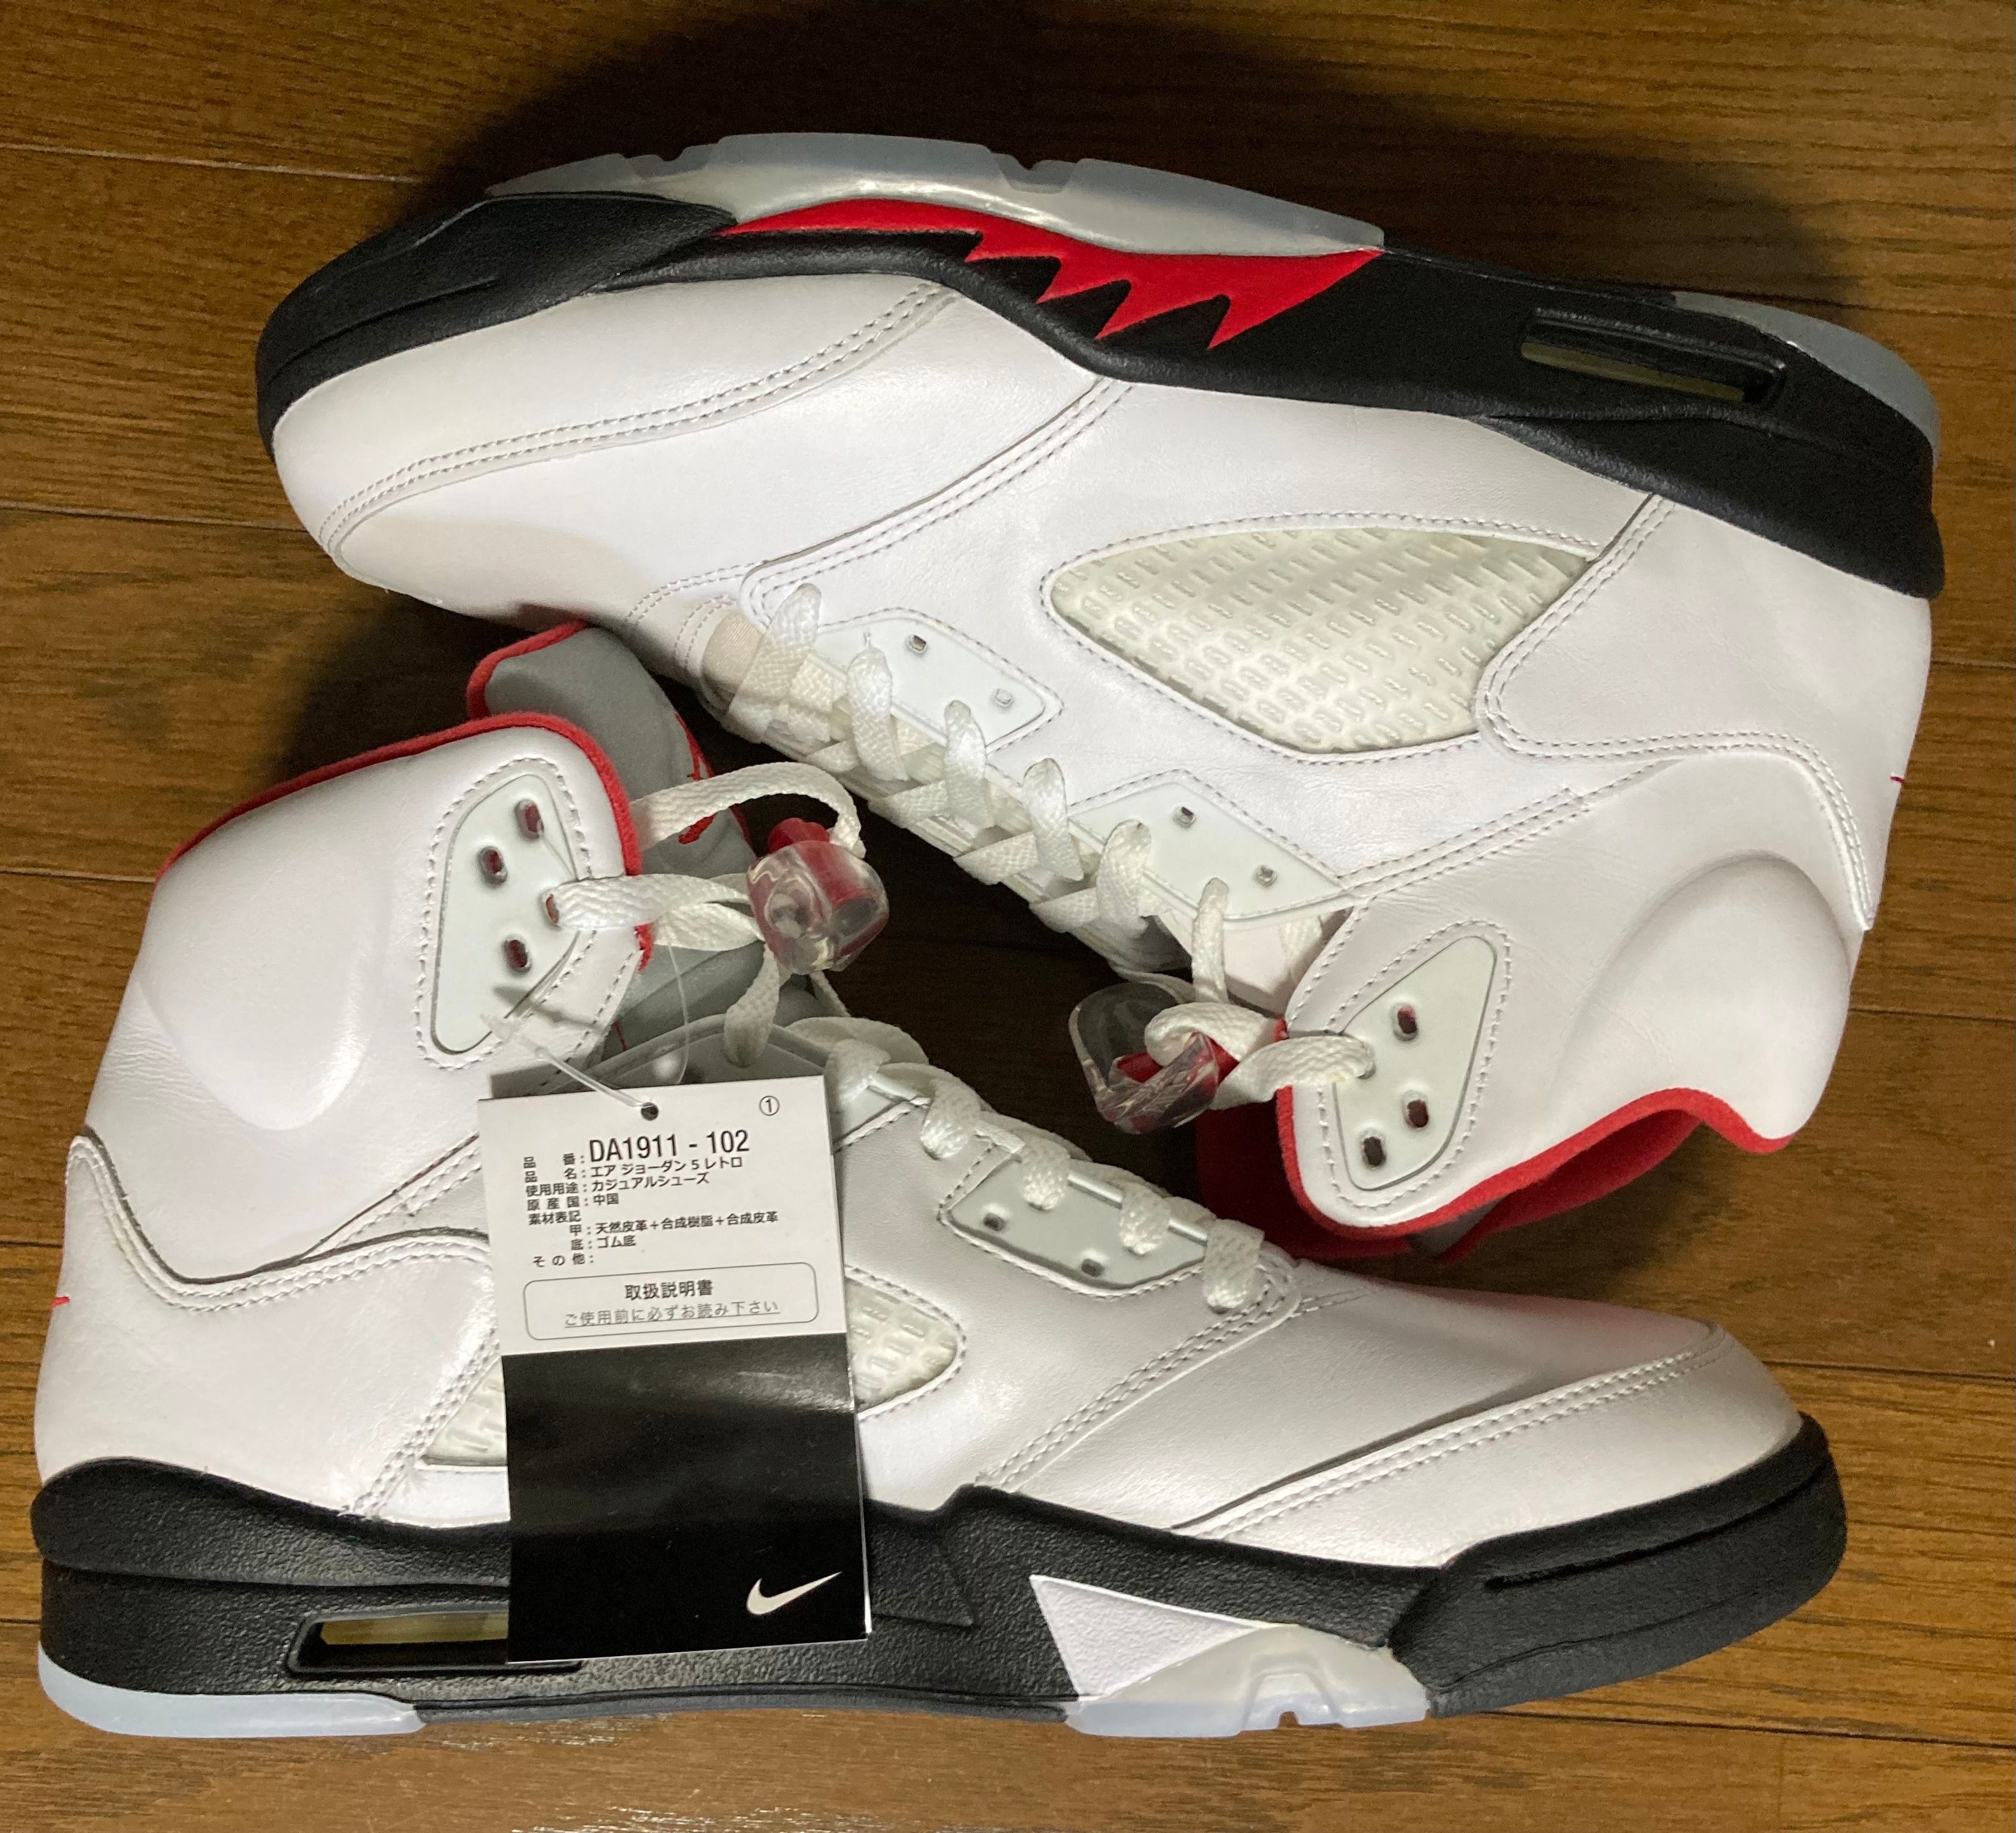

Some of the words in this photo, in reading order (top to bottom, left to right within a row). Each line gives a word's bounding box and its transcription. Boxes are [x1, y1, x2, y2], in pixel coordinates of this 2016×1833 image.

[589, 1134, 677, 1162] DA1911
[707, 1130, 750, 1154] 102
[691, 1159, 699, 1170] 5
[528, 1210, 581, 1226] 素材表記
[624, 1279, 714, 1301] 取扱説明書
[565, 1300, 779, 1326] ご使用前に必ずお読み下さい
